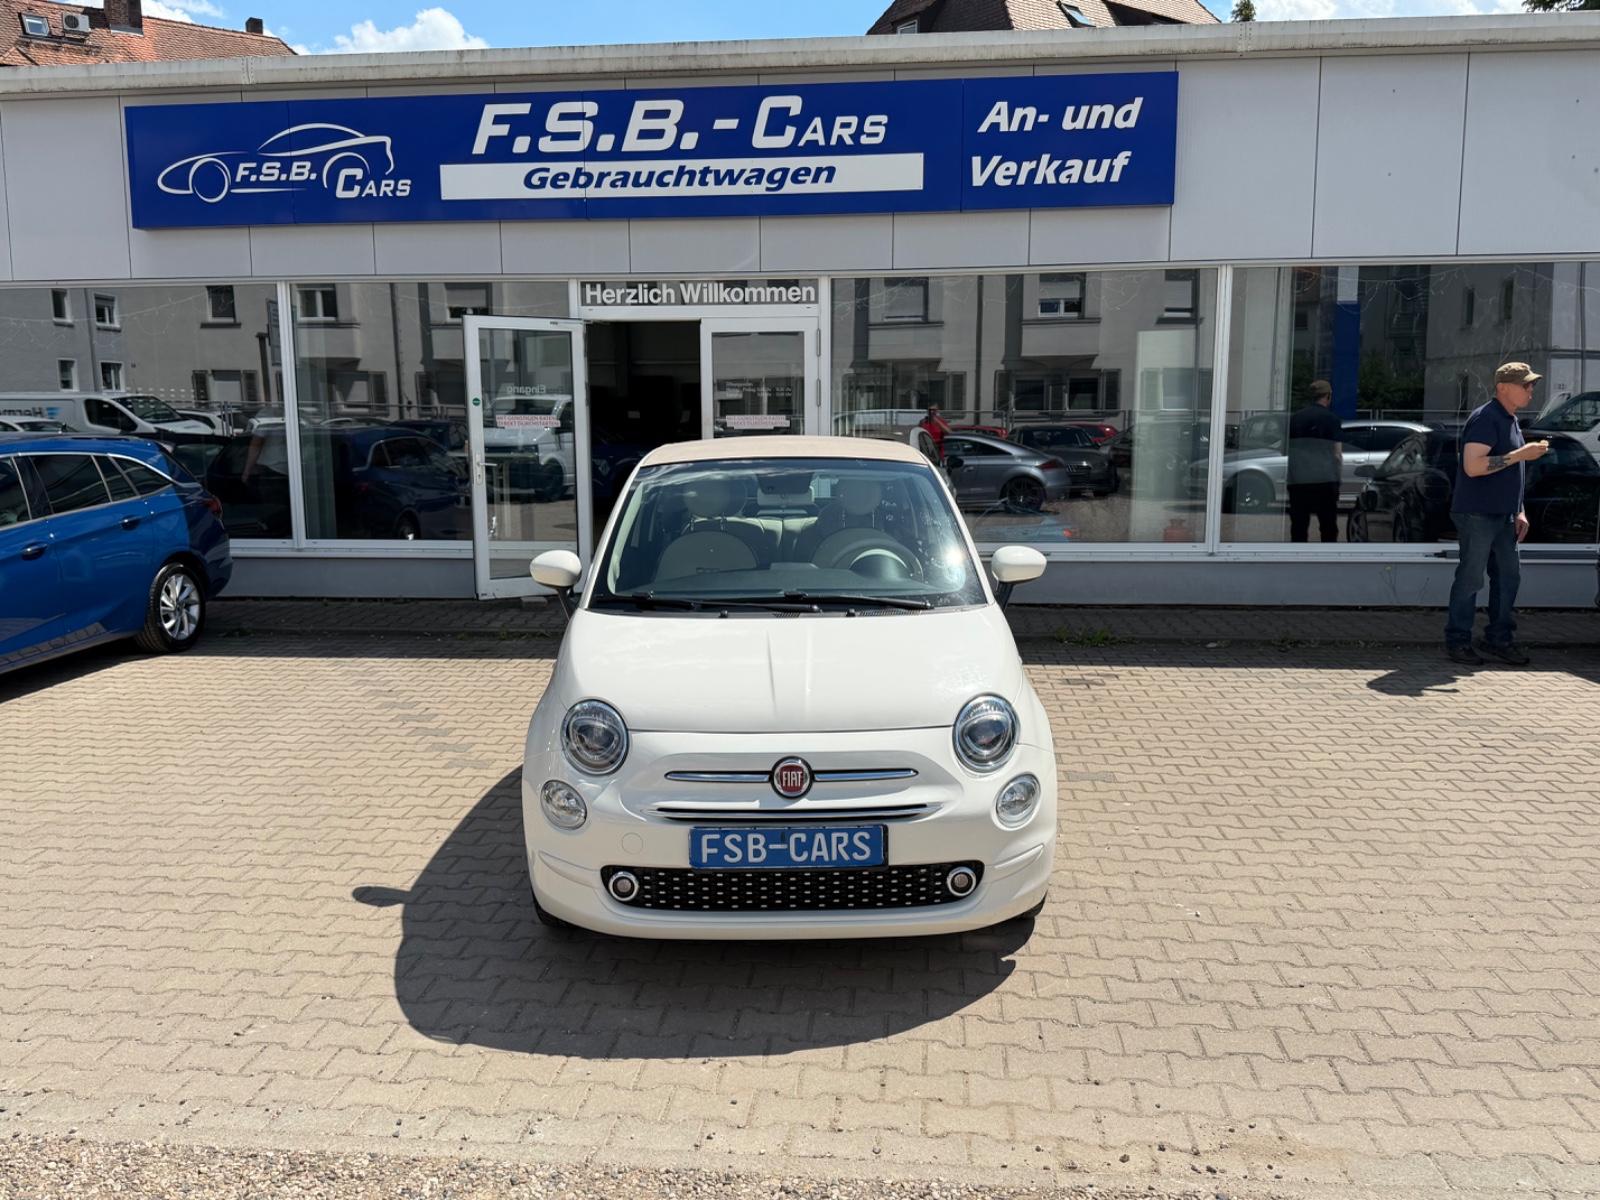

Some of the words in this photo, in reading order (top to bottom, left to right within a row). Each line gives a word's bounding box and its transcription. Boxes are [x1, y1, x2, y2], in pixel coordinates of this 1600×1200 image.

[977, 101, 1049, 133] An-
[1061, 97, 1143, 130] und
[235, 161, 317, 182] F.S.B.
[522, 165, 837, 192] Gebrauchtwagen
[971, 151, 1132, 187] Verkauf
[585, 283, 676, 304] Herzlich
[679, 282, 815, 303] Willkommen
[782, 771, 804, 787] FIAT
[701, 831, 871, 864] FSB-CARS
